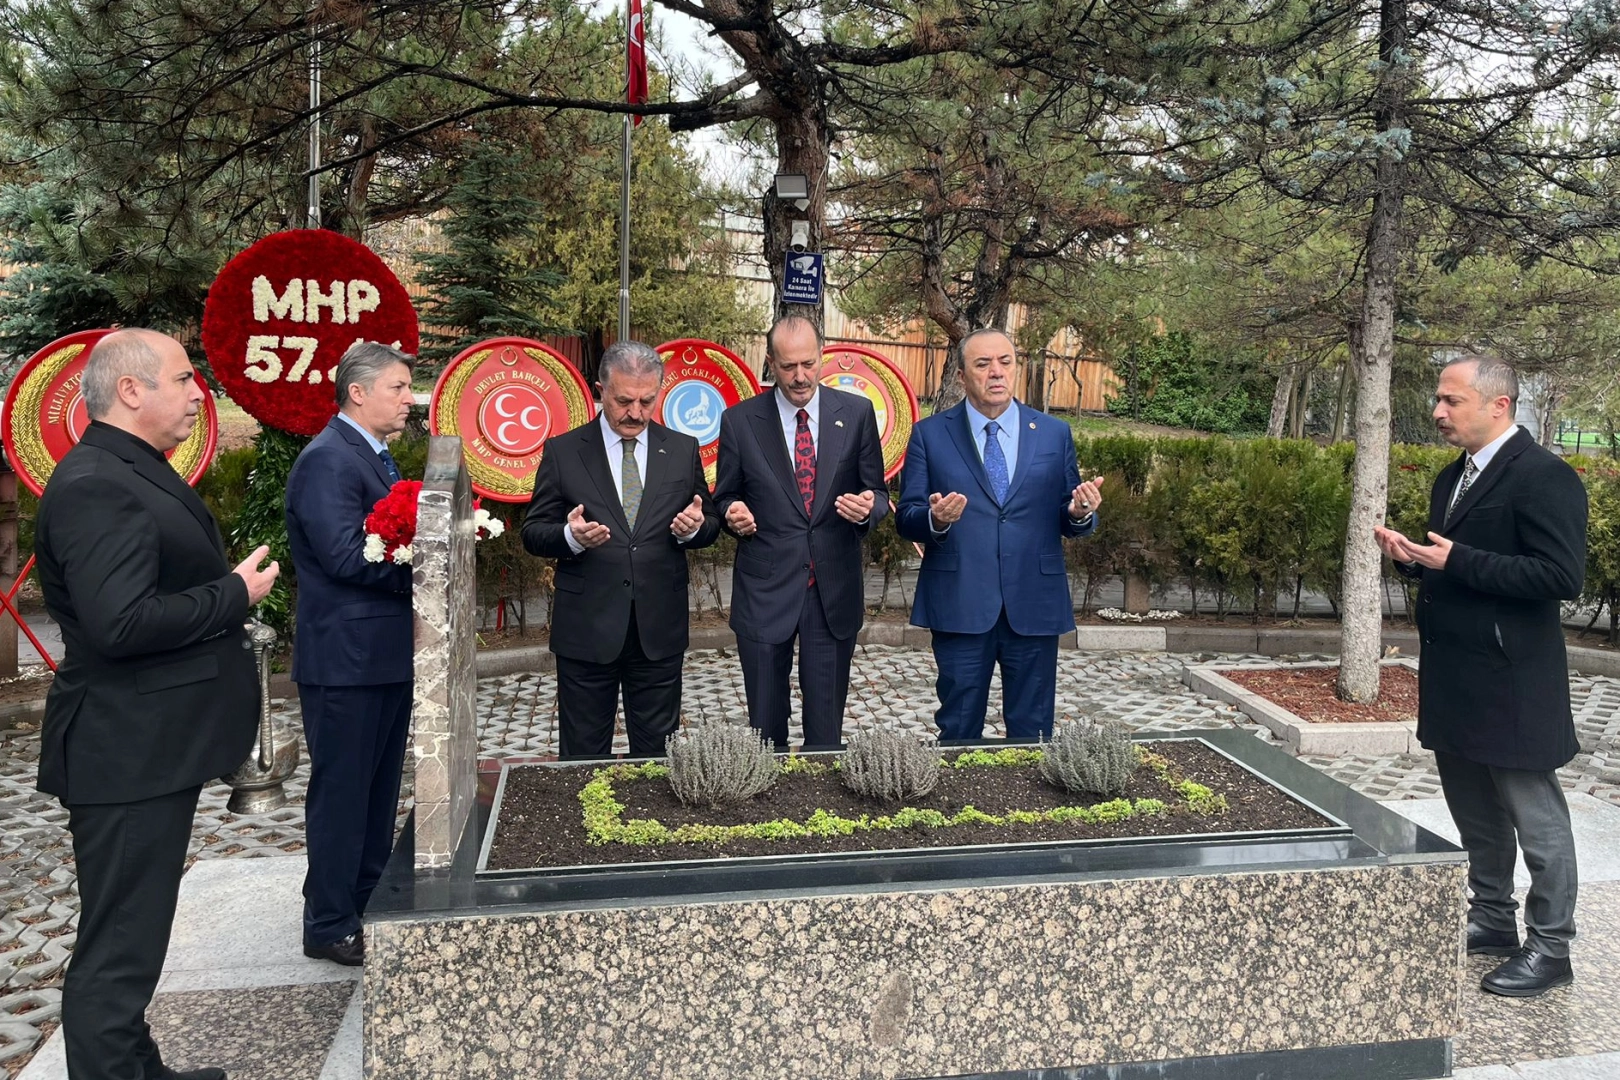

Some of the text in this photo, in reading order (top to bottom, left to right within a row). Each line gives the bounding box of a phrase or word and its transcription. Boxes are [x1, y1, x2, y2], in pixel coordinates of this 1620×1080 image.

[251, 275, 381, 324] MHP
[474, 371, 506, 395] DEVLET
[471, 438, 492, 457] MHP
[493, 456, 527, 469] GENEL
